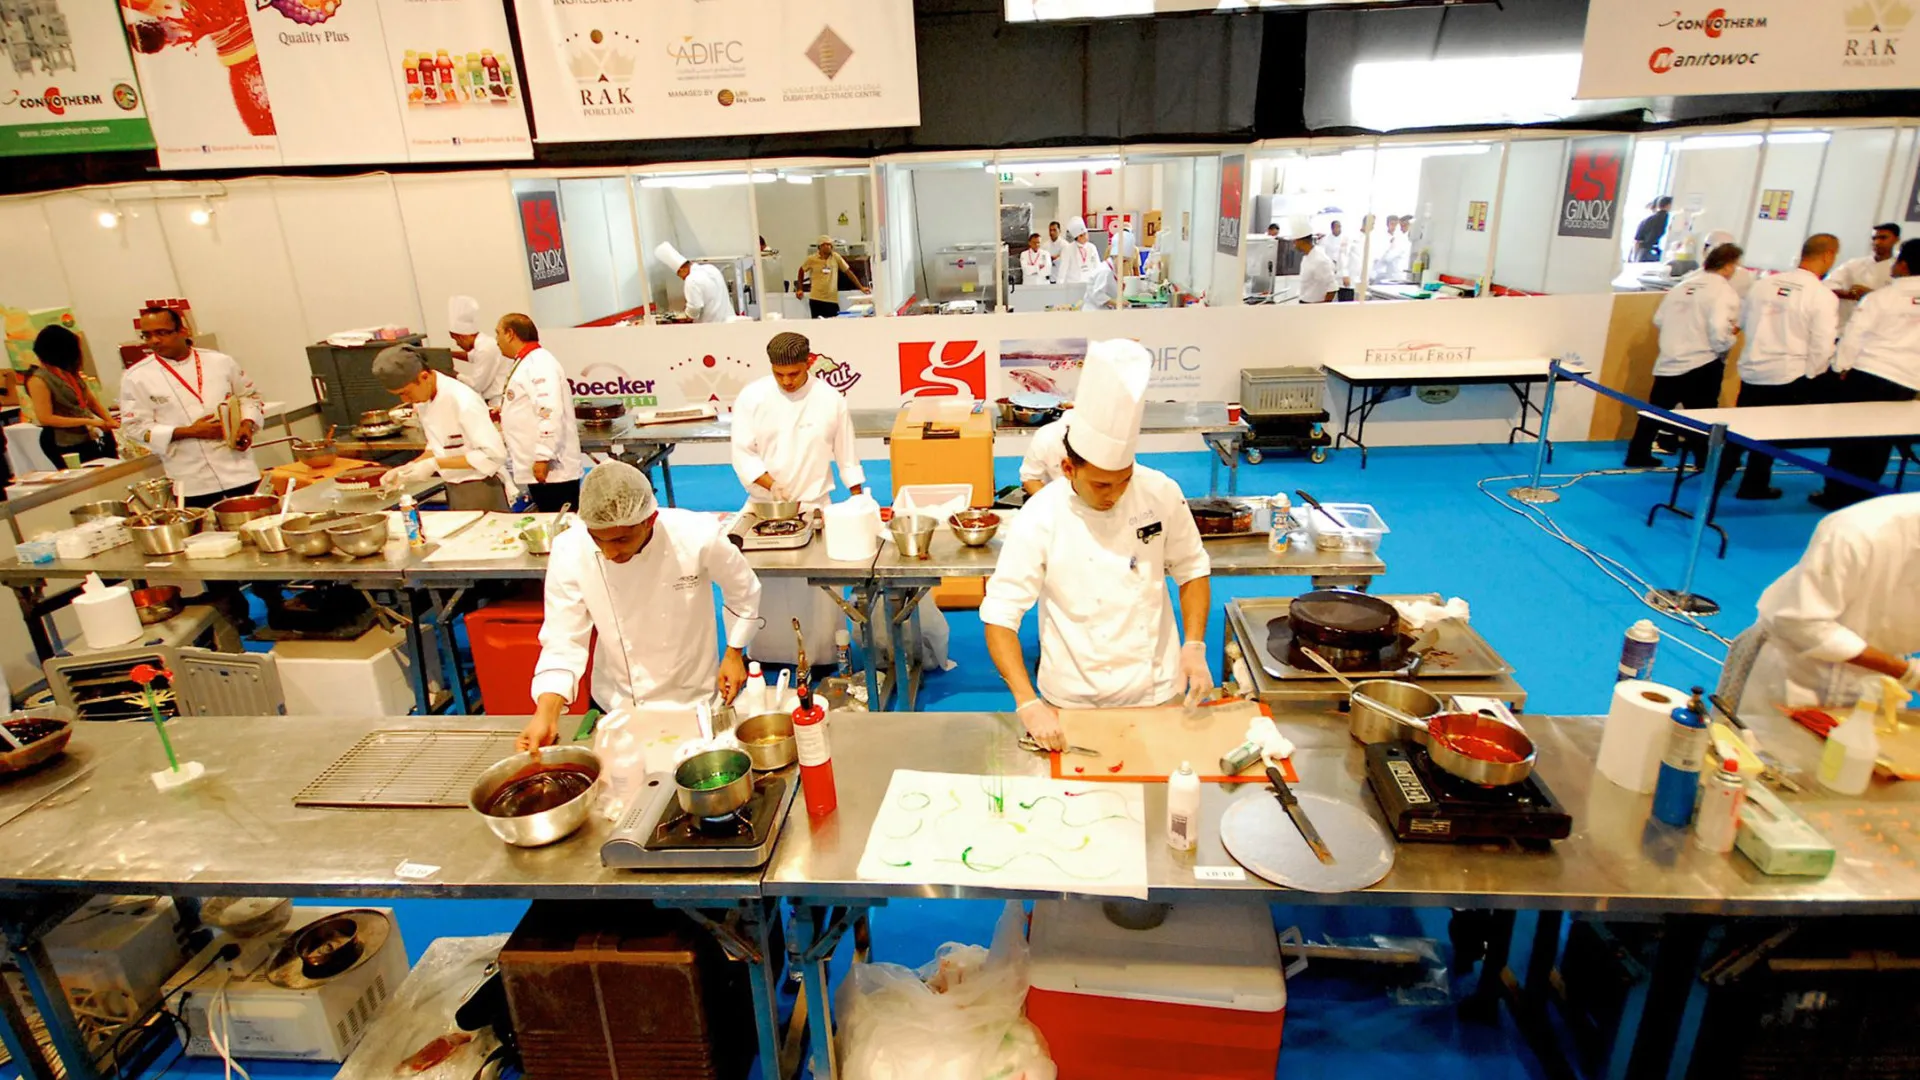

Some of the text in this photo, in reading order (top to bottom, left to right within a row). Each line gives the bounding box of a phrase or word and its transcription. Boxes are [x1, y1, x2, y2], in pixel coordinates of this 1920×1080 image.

[1676, 15, 1768, 32] CONVOTHERM
[279, 30, 350, 46] Quality Plus
[675, 40, 744, 65] ADIFC
[1845, 38, 1900, 56] RAK
[20, 93, 103, 110] CONVOTHERM
[580, 87, 632, 105] RAK
[668, 89, 702, 98] MANAGED
[783, 94, 804, 102] DUBAI
[805, 93, 830, 101] WORLD
[583, 107, 634, 116] PORCELAIN
[17, 126, 110, 138] www.convotherm.com
[1566, 199, 1612, 220] GINOX
[531, 249, 564, 273] GINOX
